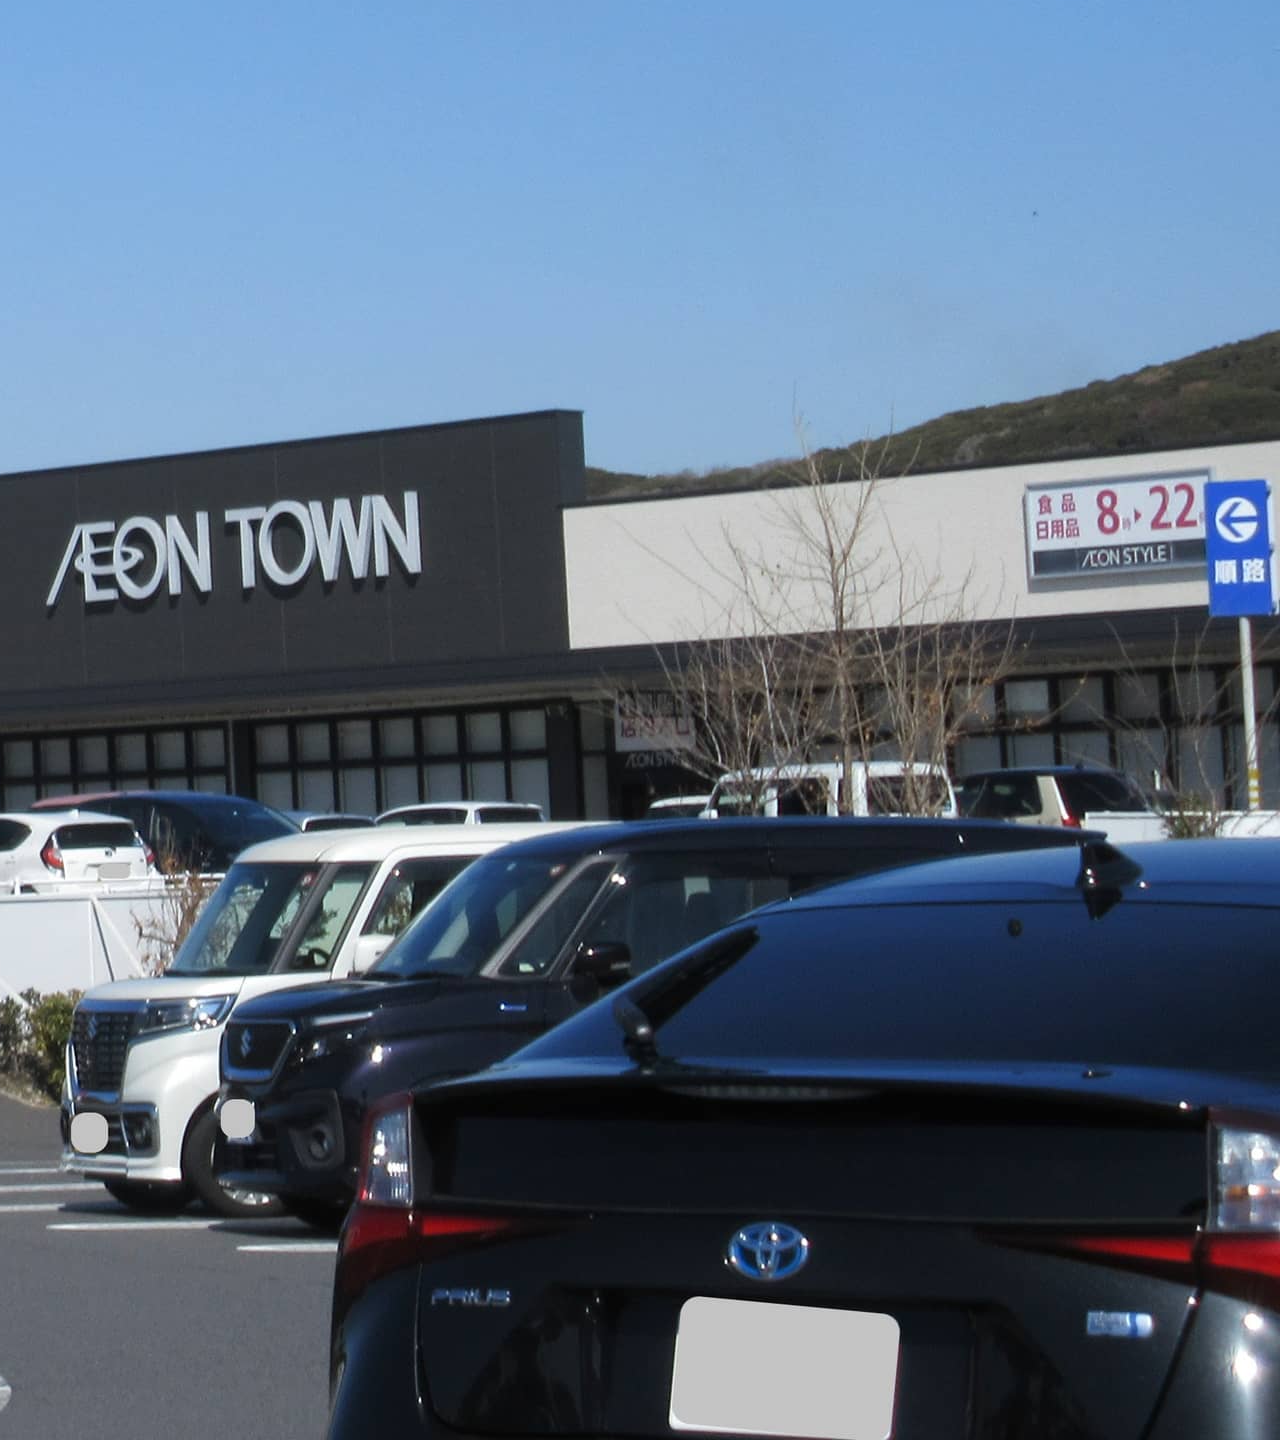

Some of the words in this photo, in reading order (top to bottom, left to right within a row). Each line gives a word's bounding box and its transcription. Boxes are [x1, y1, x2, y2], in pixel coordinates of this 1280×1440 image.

[1037, 492, 1076, 515] 食品
[224, 490, 423, 590] TOWN
[1036, 517, 1080, 541] 日用品
[1123, 544, 1168, 564] STYLE
[1214, 558, 1265, 585] 順路
